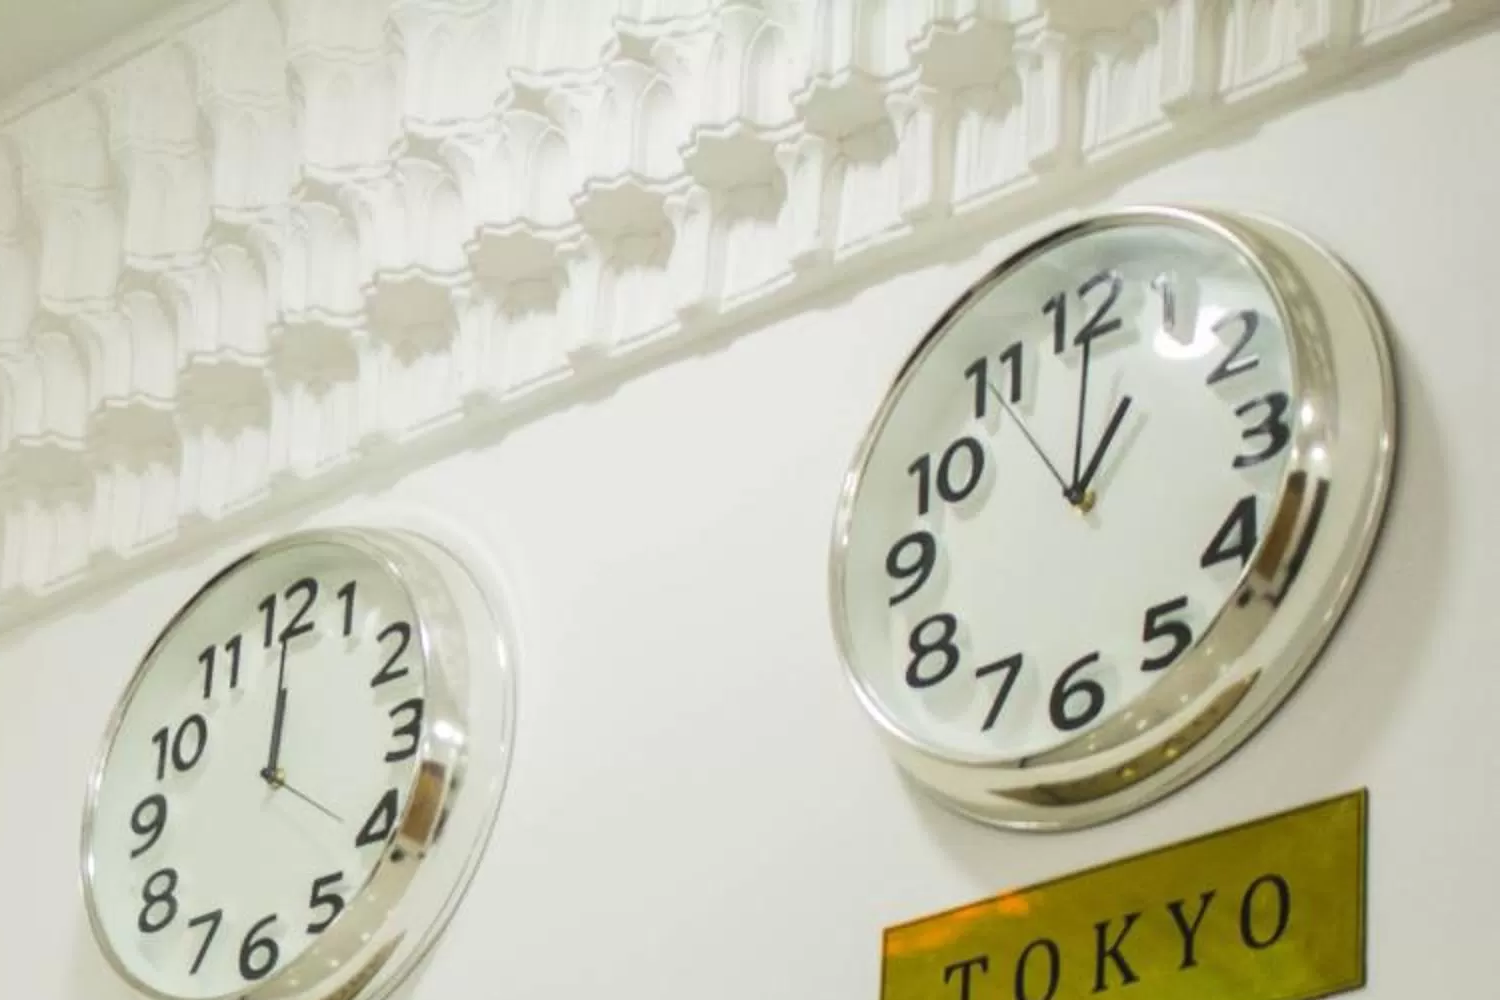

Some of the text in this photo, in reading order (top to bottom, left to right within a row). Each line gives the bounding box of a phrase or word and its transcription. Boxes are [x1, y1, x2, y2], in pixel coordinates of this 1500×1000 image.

[1043, 271, 1124, 355] 12
[1150, 270, 1177, 332] 1
[965, 341, 1024, 419] 11
[1205, 310, 1259, 387] 2
[1232, 391, 1291, 470] 3
[907, 436, 985, 516] 10
[1200, 495, 1258, 570] 4
[885, 530, 937, 608] 9
[258, 577, 319, 649] 12
[336, 580, 357, 637] 1
[1140, 596, 1193, 673] 5
[198, 635, 243, 699] 11
[370, 621, 411, 688] 2
[904, 612, 960, 690] 8
[975, 652, 1024, 733] 7
[1048, 651, 1105, 733] 6
[151, 712, 208, 781] 10
[385, 697, 424, 763] 3
[130, 793, 167, 859] 9
[355, 788, 399, 848] 4
[138, 866, 178, 933] 8
[306, 871, 345, 935] 5
[187, 908, 222, 975] 7
[238, 913, 279, 981] 6
